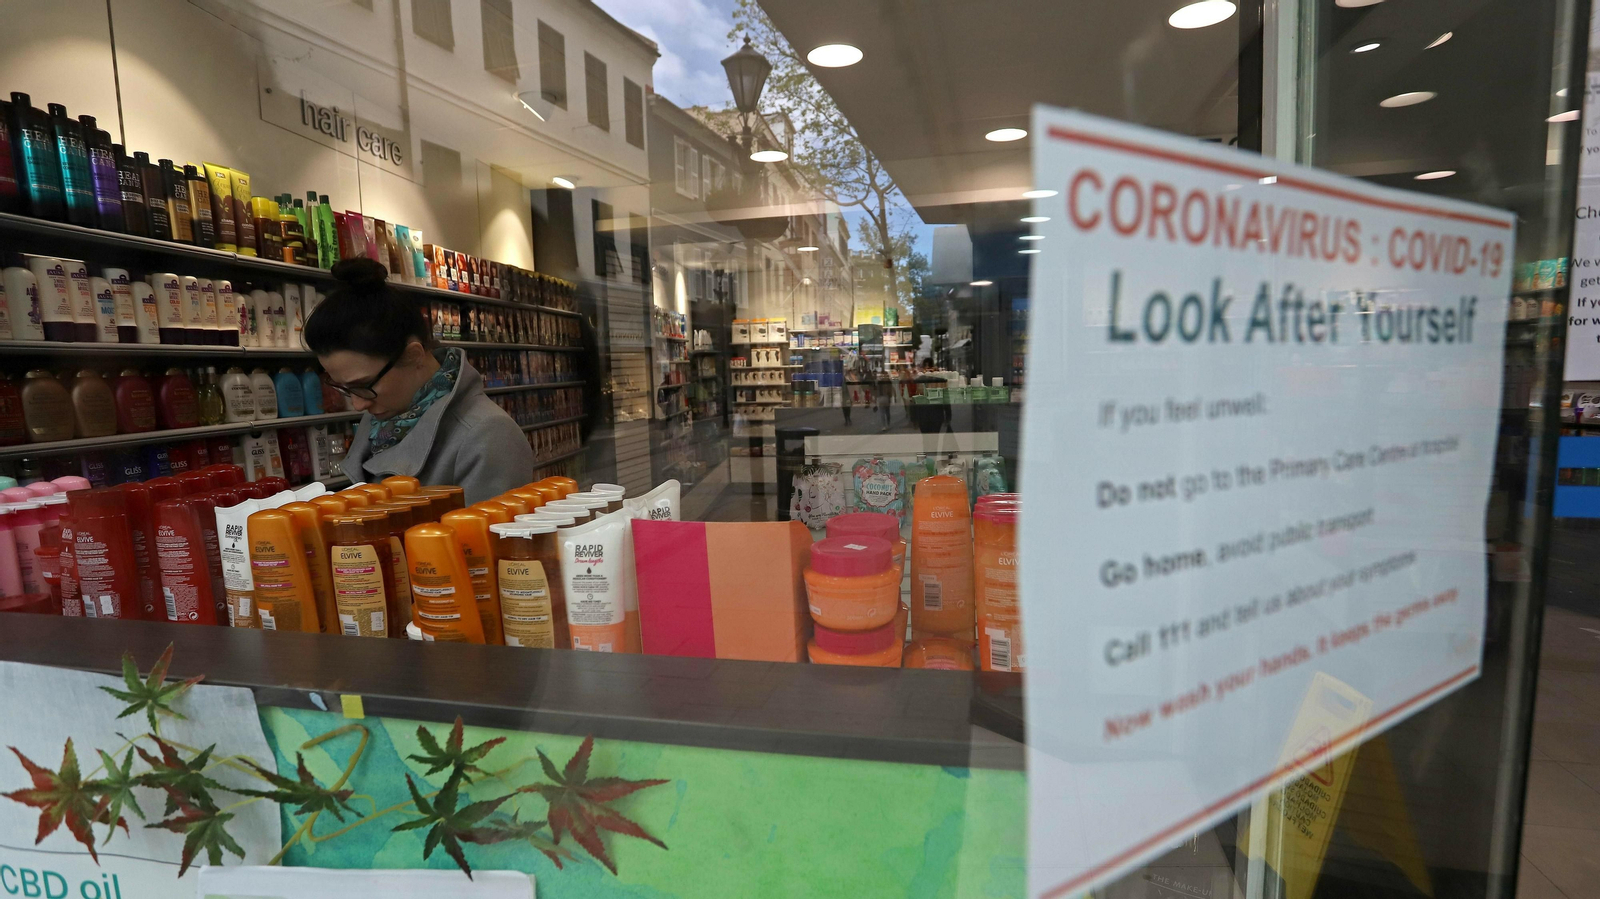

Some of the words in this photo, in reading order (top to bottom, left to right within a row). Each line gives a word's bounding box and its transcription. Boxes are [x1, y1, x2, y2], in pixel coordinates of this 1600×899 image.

[300, 89, 350, 142] hair
[357, 126, 402, 166] care
[1586, 128, 1598, 136] To
[1067, 168, 1362, 265] CORONAVIRUS
[1388, 226, 1504, 278] COVID-19
[1108, 269, 1234, 343] Look
[1245, 281, 1344, 343] After
[1356, 290, 1478, 344] Yourself
[1578, 297, 1587, 307] If
[1569, 316, 1588, 326] for
[1098, 401, 1117, 429] If
[1119, 403, 1160, 434] you
[1164, 396, 1202, 423] feel
[170, 460, 188, 469] GLISS
[125, 466, 142, 475] GLISS
[1096, 479, 1132, 509] Do
[1136, 473, 1177, 502] not
[1180, 473, 1209, 503] go
[1210, 467, 1233, 491] to
[1234, 463, 1267, 488] the
[648, 506, 670, 515] APID
[931, 511, 954, 519] ELVIVE
[226, 524, 243, 532] RAPID
[998, 557, 1020, 565] ELVIV
[416, 567, 437, 575] ELVIVE
[1098, 558, 1138, 589] Go
[1103, 631, 1152, 668] Call
[1158, 619, 1192, 650] 111
[1195, 608, 1232, 639] and
[1103, 710, 1153, 743] Now
[1158, 681, 1211, 719] wash
[1214, 665, 1256, 701] your
[0, 864, 68, 899] CBD
[80, 873, 121, 899] oil
[1152, 874, 1170, 884] THE
